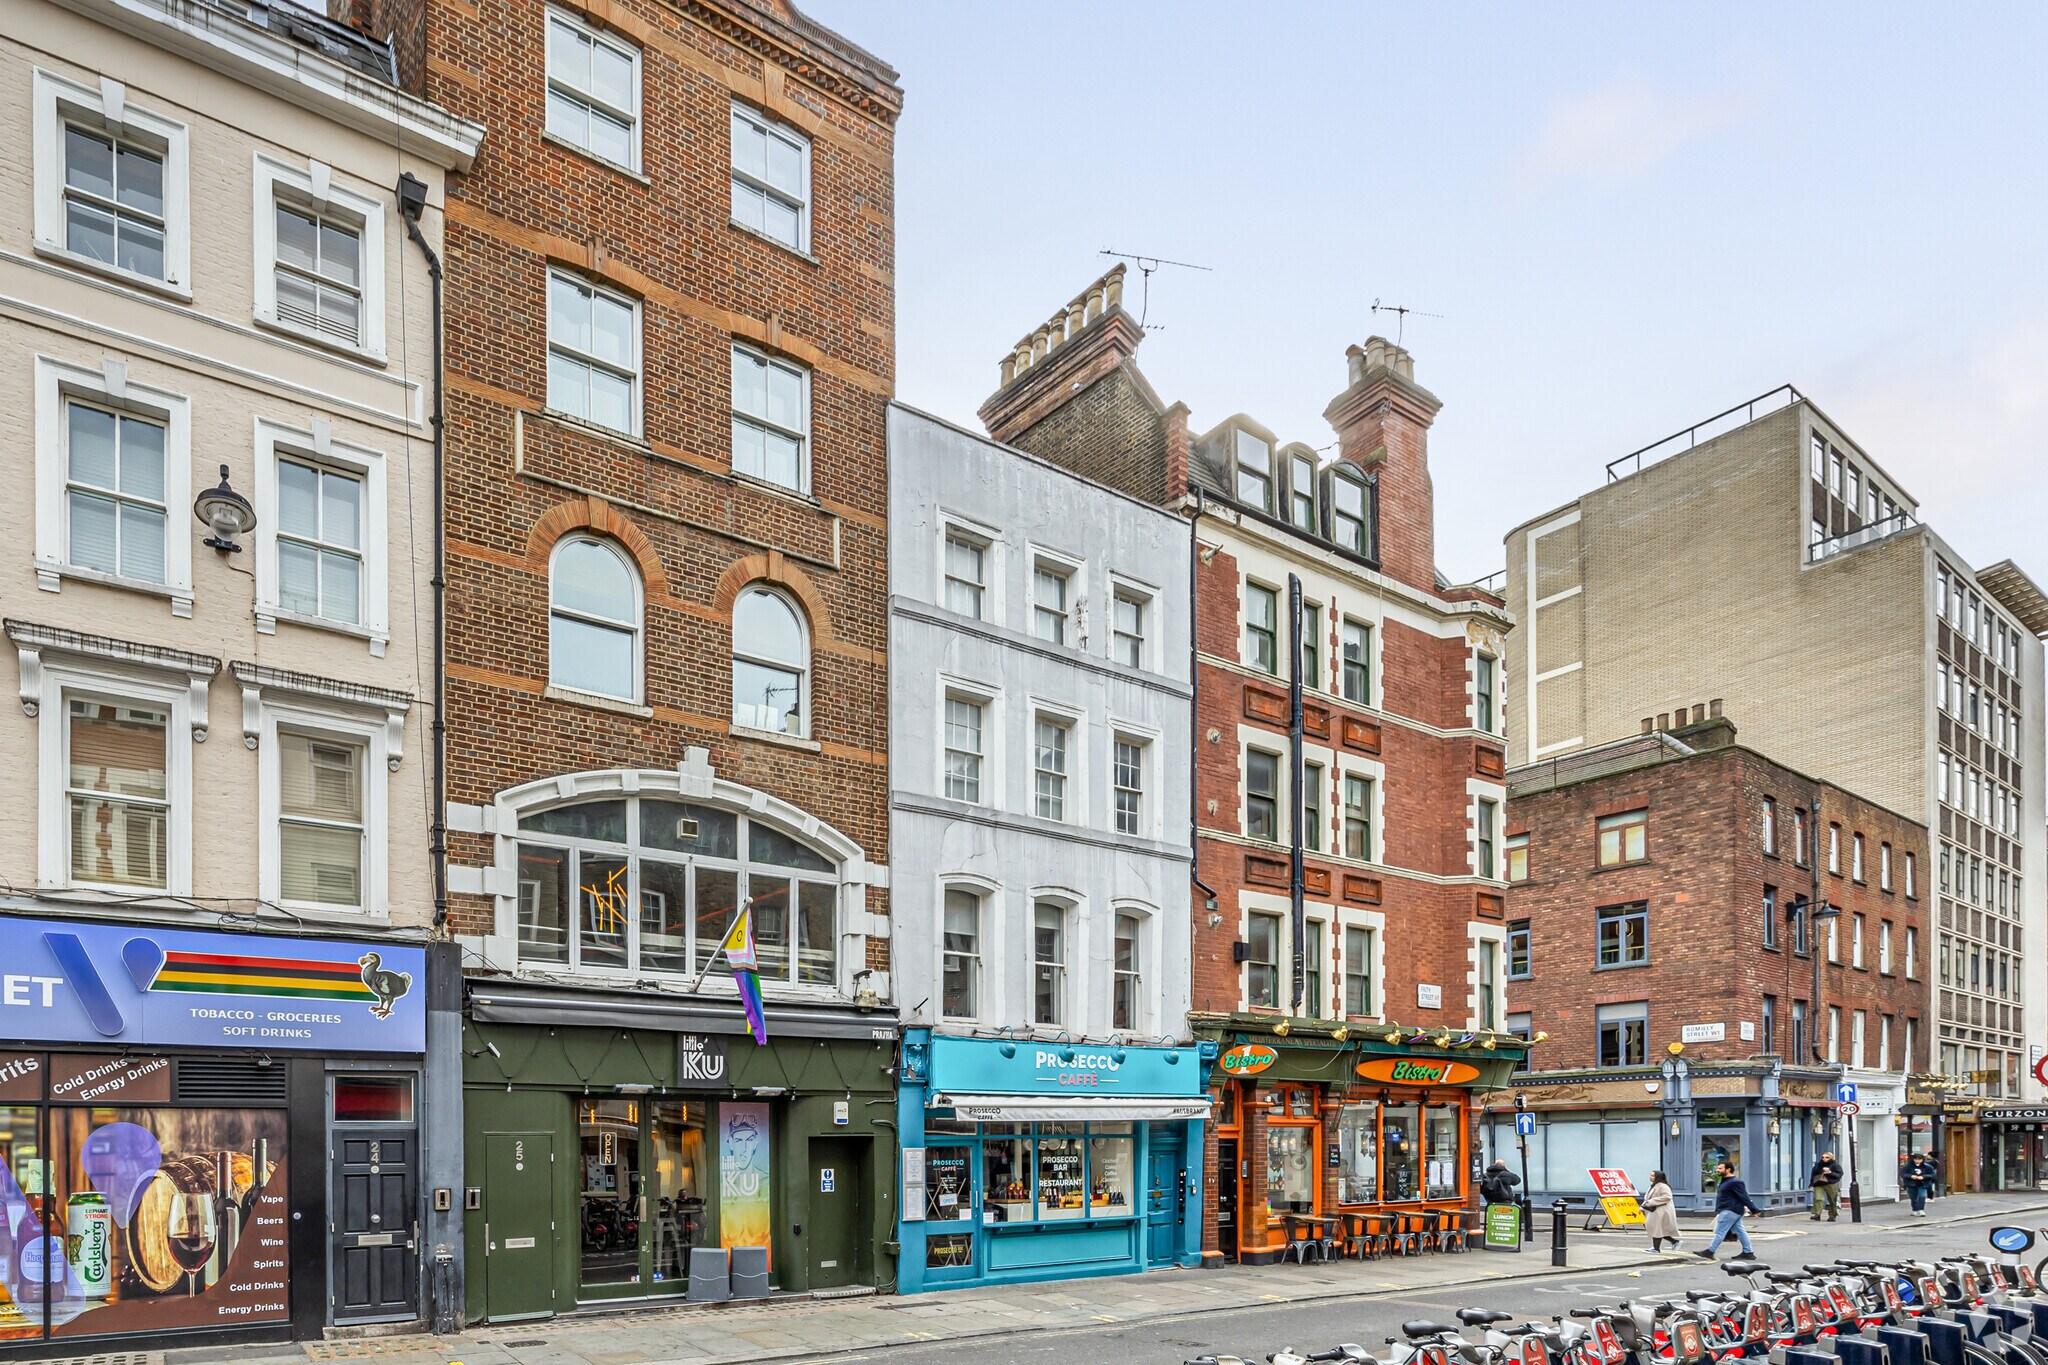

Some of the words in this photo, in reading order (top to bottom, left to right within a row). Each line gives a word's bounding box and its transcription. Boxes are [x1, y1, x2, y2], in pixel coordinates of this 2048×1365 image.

[190, 1008, 254, 1020] TOBACCO
[267, 1011, 342, 1024] GROCERIES
[223, 1026, 256, 1036] SOFT
[261, 1028, 312, 1038] DRINKS
[1224, 1054, 1272, 1069] Bistro
[53, 1075, 85, 1094] Cold
[85, 1058, 128, 1081] Drinks
[80, 1076, 125, 1100] Energy
[127, 1058, 168, 1081] Drinks
[1058, 1070, 1098, 1086] CAFFÈ
[1392, 1061, 1441, 1080] Bistro
[1439, 1064, 1454, 1083] 1
[1944, 1104, 1972, 1112] Massage
[370, 1142, 379, 1163] 24
[516, 1140, 523, 1160] 25
[1039, 1178, 1082, 1187] RESTAURANT
[261, 1195, 284, 1205] Vape
[257, 1217, 284, 1225] Beers
[84, 1221, 105, 1283] Carlsberg
[254, 1260, 284, 1270] Spirits
[230, 1283, 252, 1292] Cold
[254, 1281, 284, 1290] Drinks
[218, 1306, 252, 1315] Energy
[254, 1302, 284, 1312] Drinks
